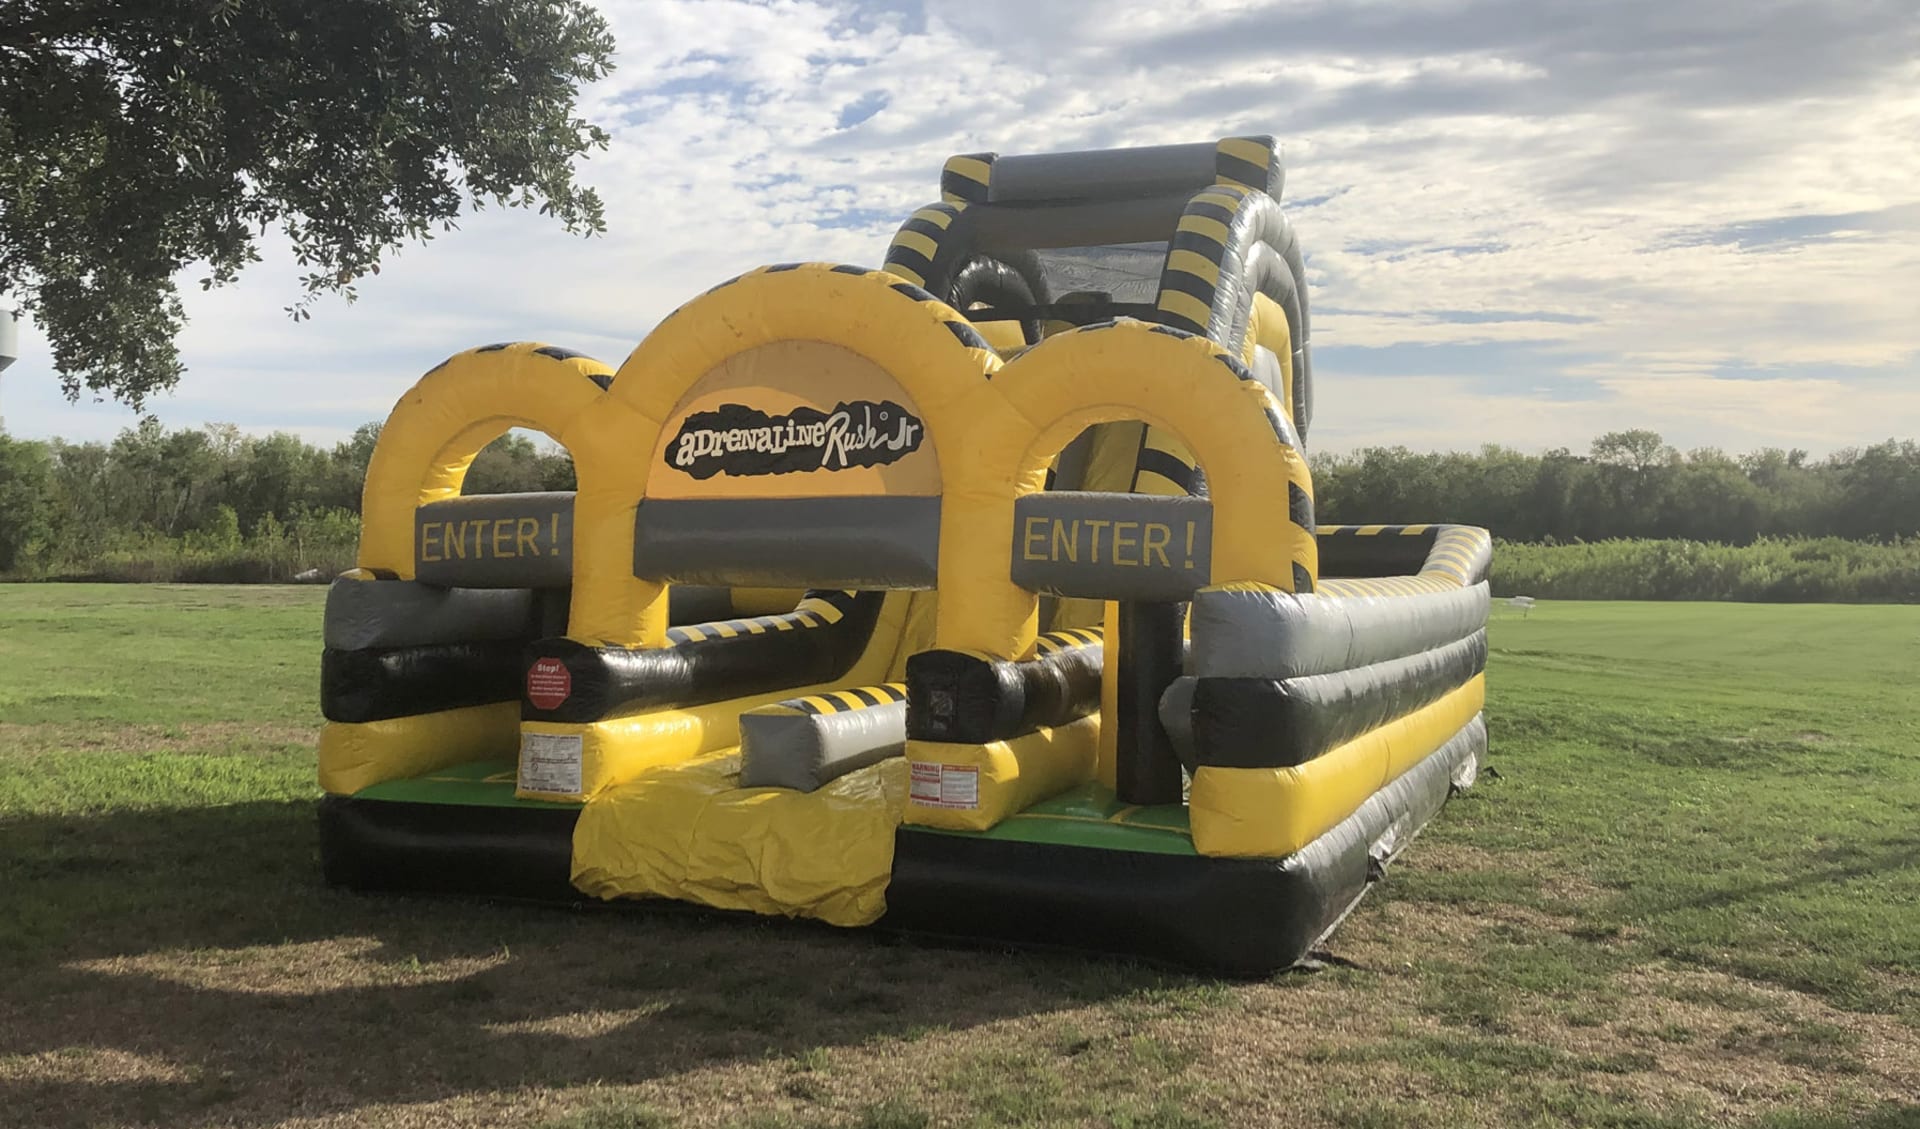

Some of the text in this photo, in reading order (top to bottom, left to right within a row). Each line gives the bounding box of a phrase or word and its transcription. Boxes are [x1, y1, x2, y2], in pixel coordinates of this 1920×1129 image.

[887, 417, 919, 450] Jr
[421, 513, 560, 562] ENTER!
[1023, 516, 1196, 569] ENTER!
[537, 663, 560, 674] Stop!
